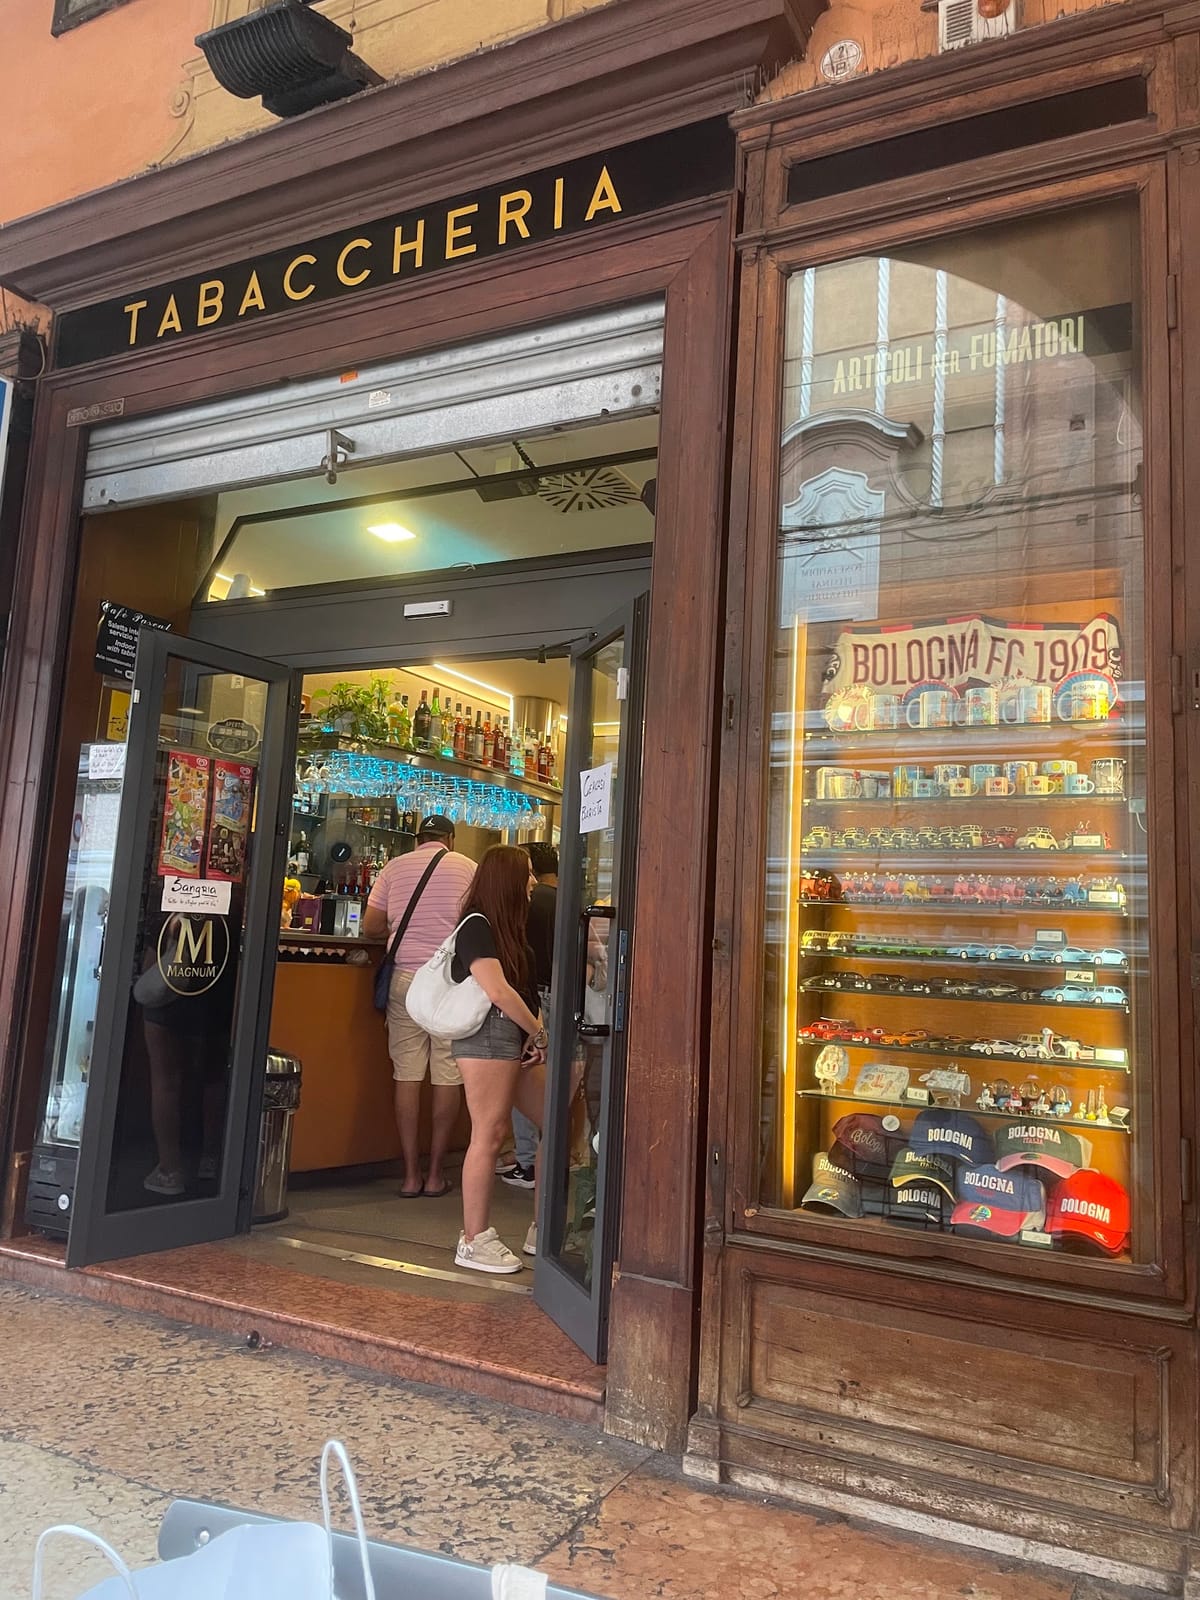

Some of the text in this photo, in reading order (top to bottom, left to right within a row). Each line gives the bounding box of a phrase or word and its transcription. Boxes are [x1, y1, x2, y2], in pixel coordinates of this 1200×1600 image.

[124, 165, 622, 345] TABACCHERIA
[833, 346, 923, 394] ARTICOLI
[969, 316, 1084, 371] FUMATORI
[107, 620, 128, 633] Saletta
[109, 629, 133, 641] servizio
[106, 645, 121, 654] with
[114, 639, 136, 651] Indoor
[851, 629, 979, 686] BOLOGNA
[1034, 628, 1108, 683] 1909
[173, 918, 214, 964] M
[167, 965, 216, 978] MAGNUM
[928, 1128, 973, 1151] BOLOGNA
[1008, 1126, 1061, 1145] BOLOGNA
[964, 1171, 1015, 1195] BOLOGNA
[897, 1189, 941, 1209] BOLOGNA
[1060, 1198, 1111, 1224] BOLOGNA
